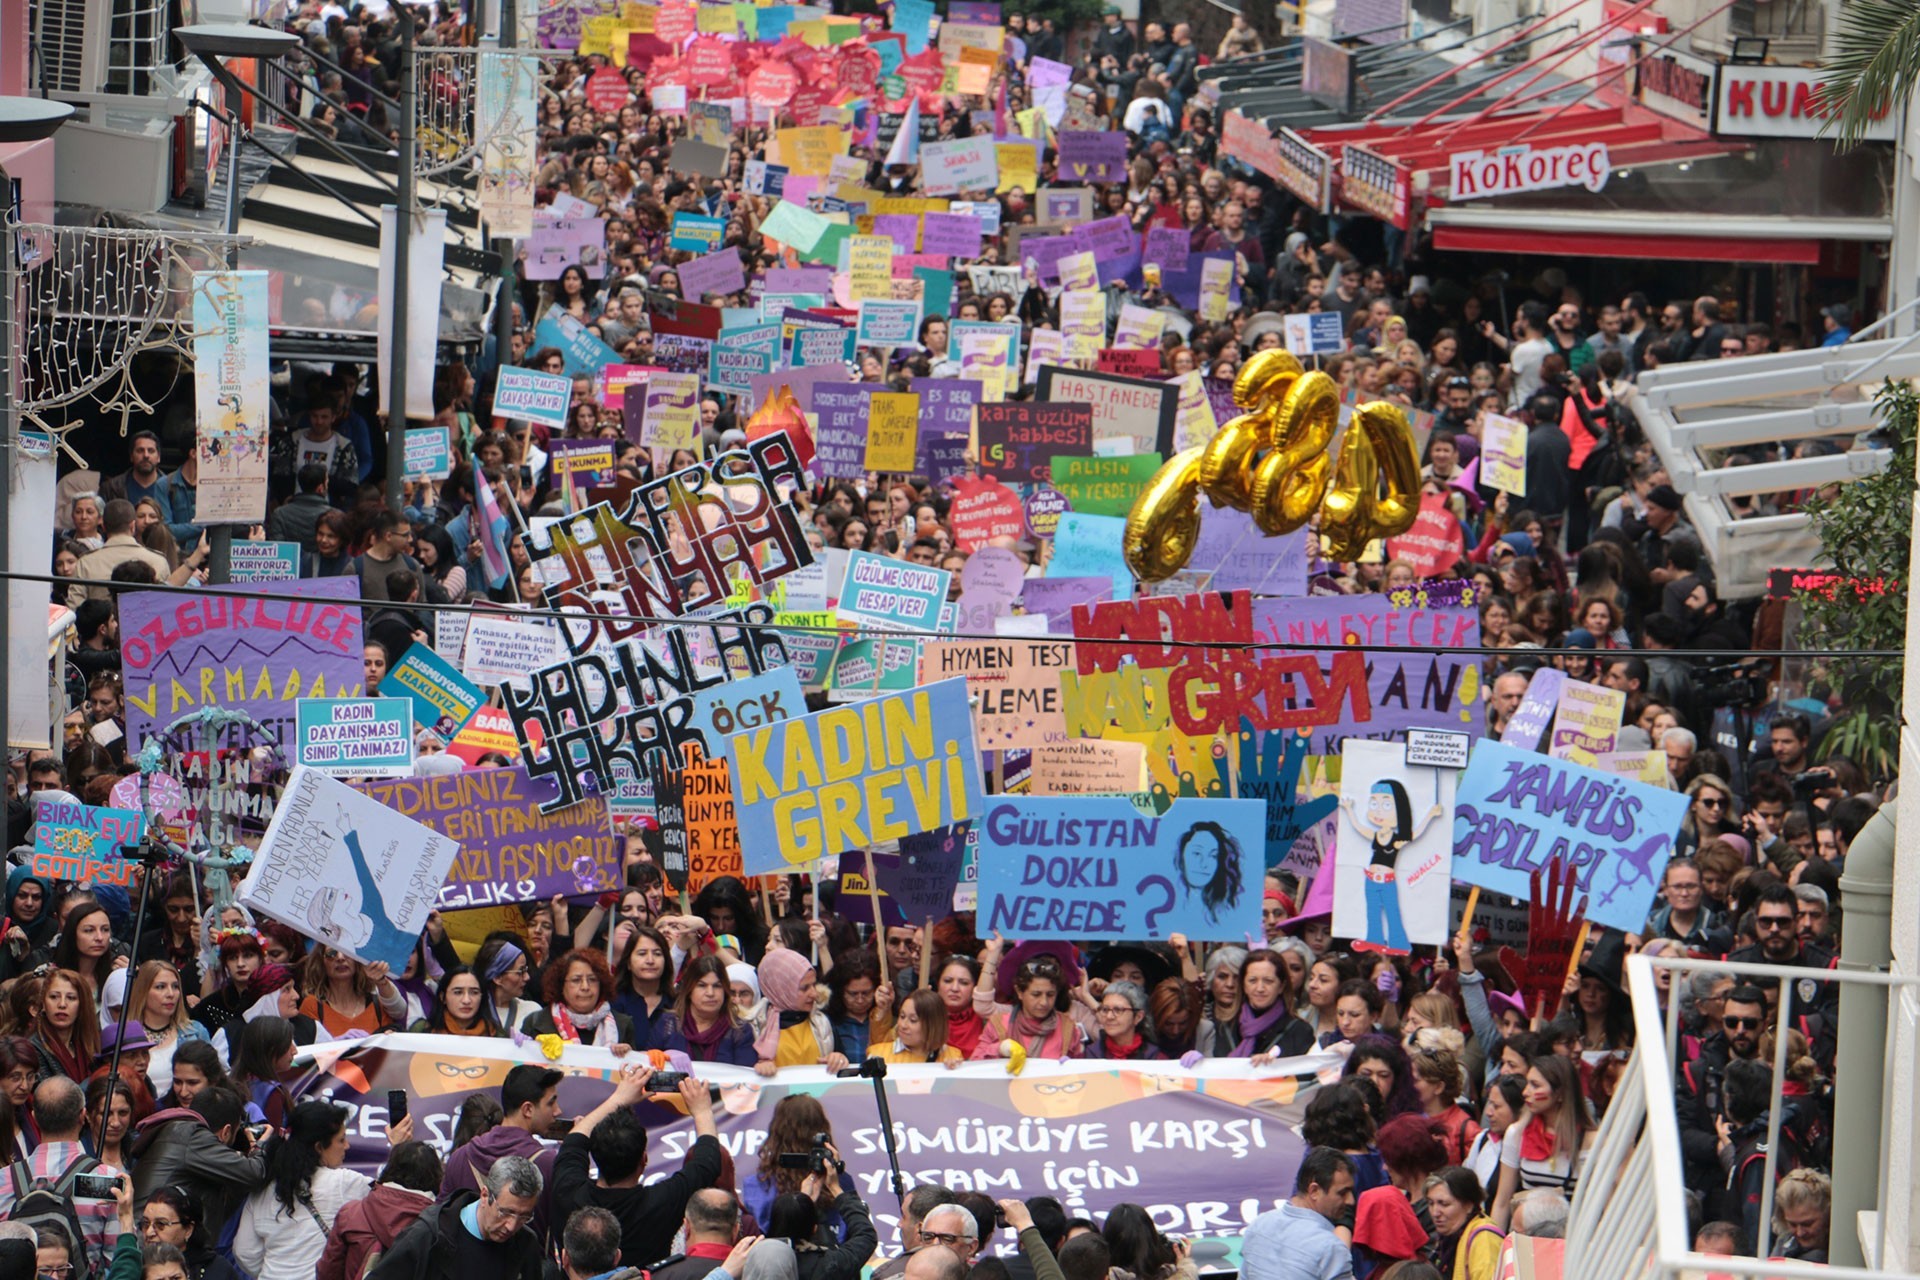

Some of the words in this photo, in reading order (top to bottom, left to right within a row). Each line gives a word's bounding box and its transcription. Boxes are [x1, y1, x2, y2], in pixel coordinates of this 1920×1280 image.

[1457, 149, 1602, 196] KoKoreç
[1061, 382, 1161, 410] HASTANEDE
[980, 405, 1030, 423] kara
[1036, 408, 1090, 428] üzüm
[229, 560, 293, 571] AYKIRIYORUZ:
[232, 542, 278, 557] HAKİKATİ
[855, 558, 900, 587] ÜZÜLME
[901, 570, 939, 596] SOYLU,
[857, 590, 897, 613] HESAP
[439, 633, 461, 642] Kara
[472, 627, 512, 641] Amasız,
[475, 637, 496, 648] Tam
[499, 641, 531, 653] eşitlik
[941, 645, 1015, 673] HYMEN
[1028, 644, 1073, 667] TEST
[333, 703, 375, 723] KADIN
[709, 689, 789, 735] ÖGK
[308, 722, 401, 743] DAYANIŞMASI
[731, 690, 936, 806] KADIN
[304, 744, 346, 763] SINIR
[349, 738, 408, 759] TANIMAZ!
[331, 768, 347, 776] KADIN
[347, 767, 373, 776] SAVUNMA
[1048, 782, 1083, 793] KADIN
[278, 769, 324, 843] KADINLAR
[771, 738, 968, 865] GREVİ
[1487, 759, 1645, 843] KAMPÜS
[37, 801, 99, 830] BIRAK
[100, 813, 141, 843] EVİ
[986, 803, 1162, 848] GÜLİSTAN
[53, 826, 100, 854] BOK
[395, 890, 419, 930] KADIN
[409, 834, 443, 893] SAVUNMA
[1020, 853, 1120, 889] DOKU
[1406, 853, 1443, 886] MUALLA
[286, 884, 315, 921] HER
[988, 892, 1127, 934] NEREDE
[850, 1117, 1109, 1157] SÖMÜRÜYE
[1129, 1117, 1267, 1160] KARŞI
[1043, 1160, 1140, 1198] İÇİN
